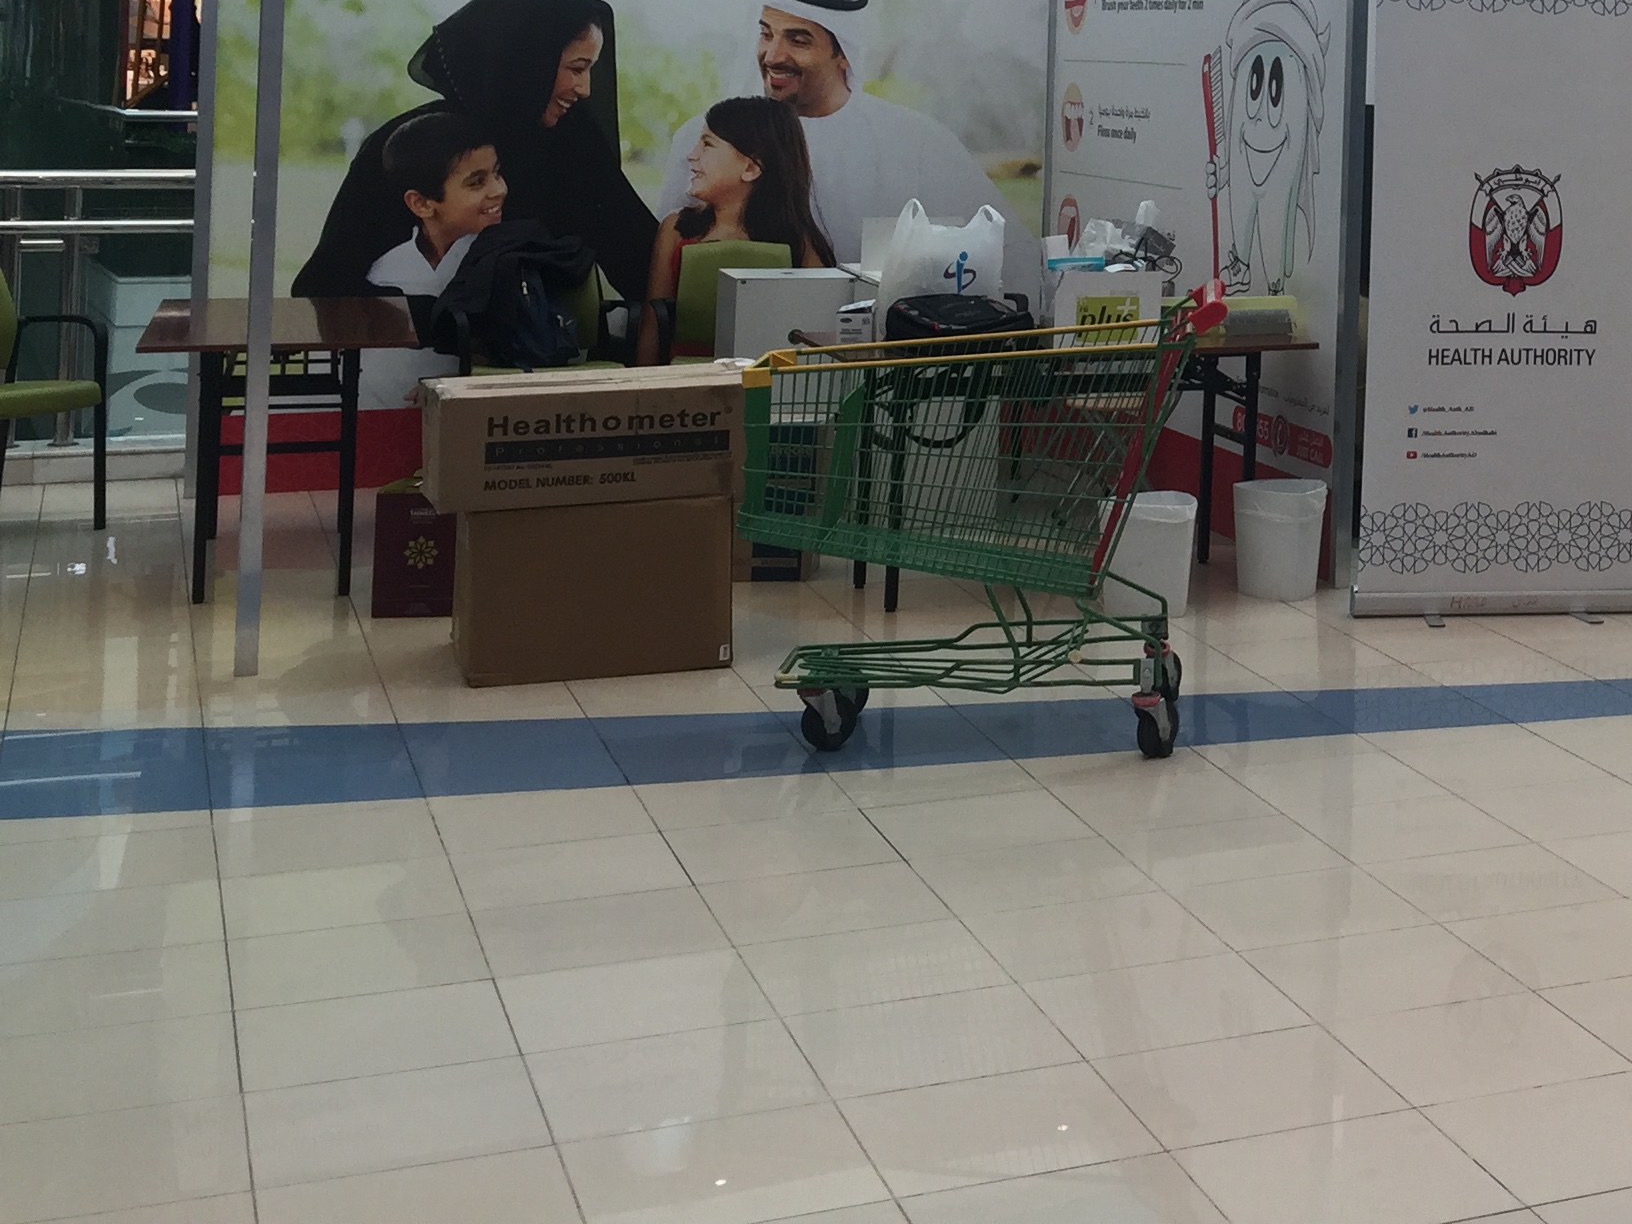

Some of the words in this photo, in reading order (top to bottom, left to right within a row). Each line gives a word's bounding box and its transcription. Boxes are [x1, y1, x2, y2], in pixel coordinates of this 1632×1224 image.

[1117, 1, 1129, 14] your
[1110, 128, 1123, 140] once
[1123, 126, 1137, 144] daily
[1429, 312, 1515, 334] الصحة
[1523, 314, 1597, 339] هيئة
[1428, 348, 1493, 366] HEALTH
[1497, 348, 1597, 366] AUTHORITY
[487, 409, 721, 437] Healthometer
[484, 479, 532, 492] MODEL
[535, 475, 594, 489] NUMBER:
[599, 471, 637, 485] 500KL
